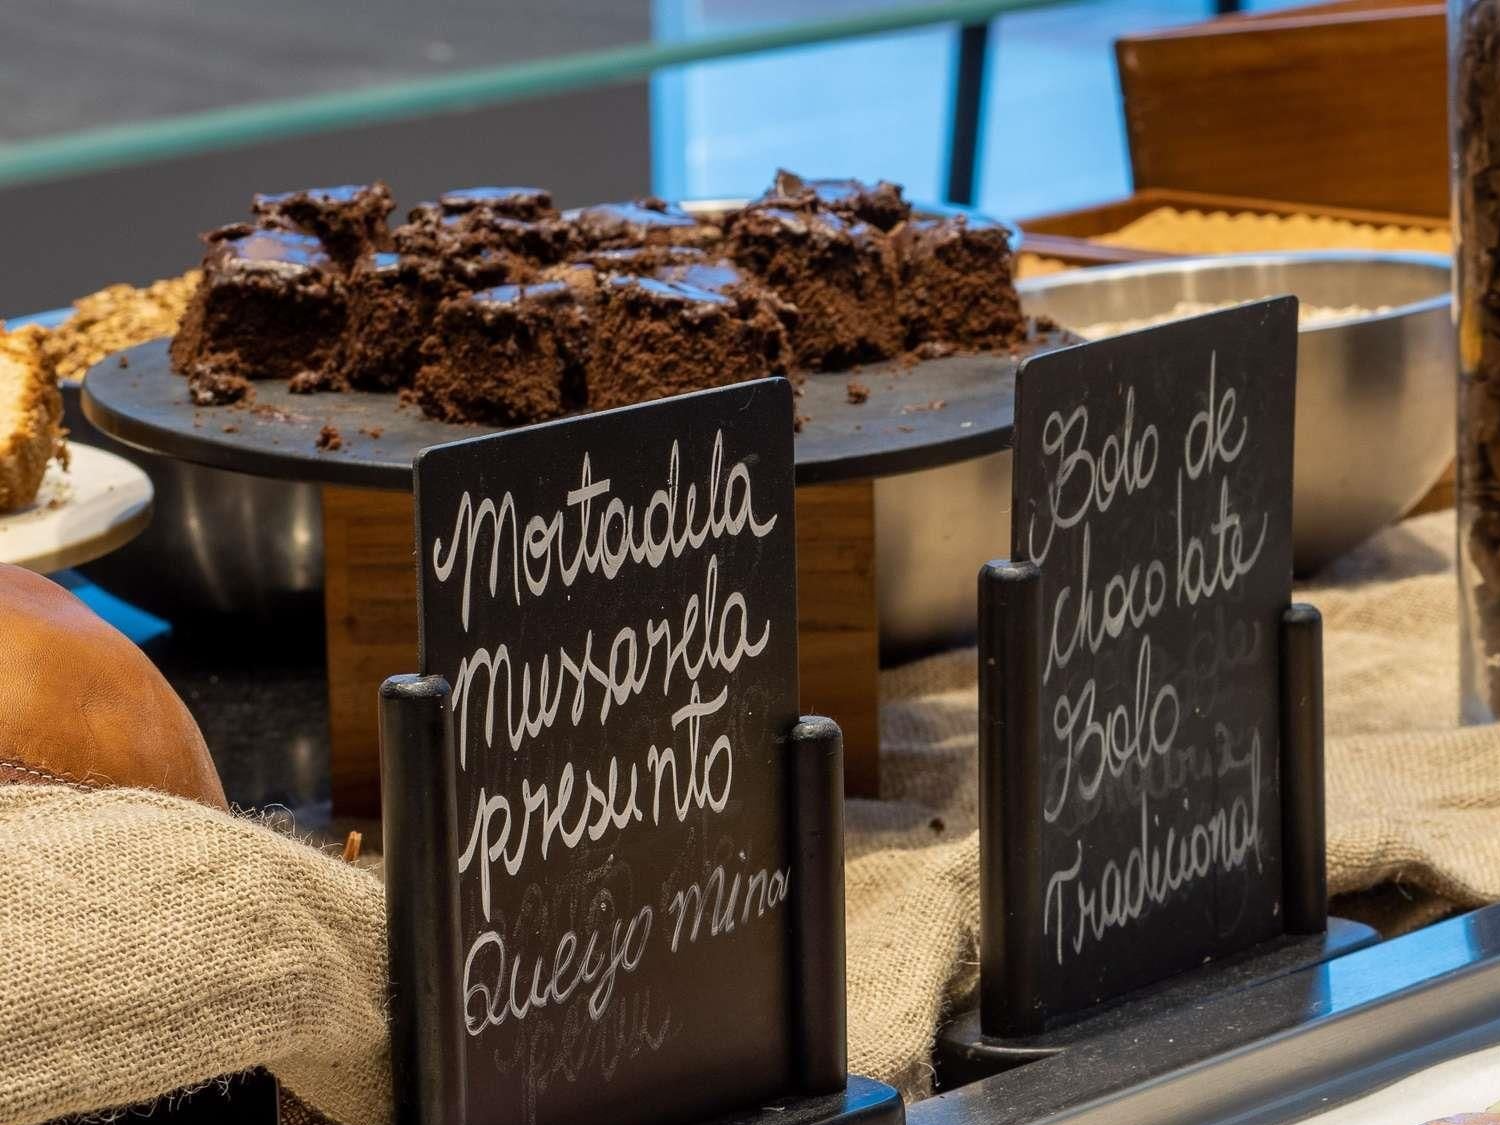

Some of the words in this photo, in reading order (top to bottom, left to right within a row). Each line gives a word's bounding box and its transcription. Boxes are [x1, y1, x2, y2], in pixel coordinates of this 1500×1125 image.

[433, 430, 777, 632] Mortadela
[1029, 385, 1159, 564] Bolo
[1184, 350, 1247, 481] de
[457, 683, 732, 922] presunto
[1043, 637, 1179, 822] Bolo
[1042, 730, 1264, 966] Tradicional
[463, 906, 654, 1036] Queijo
